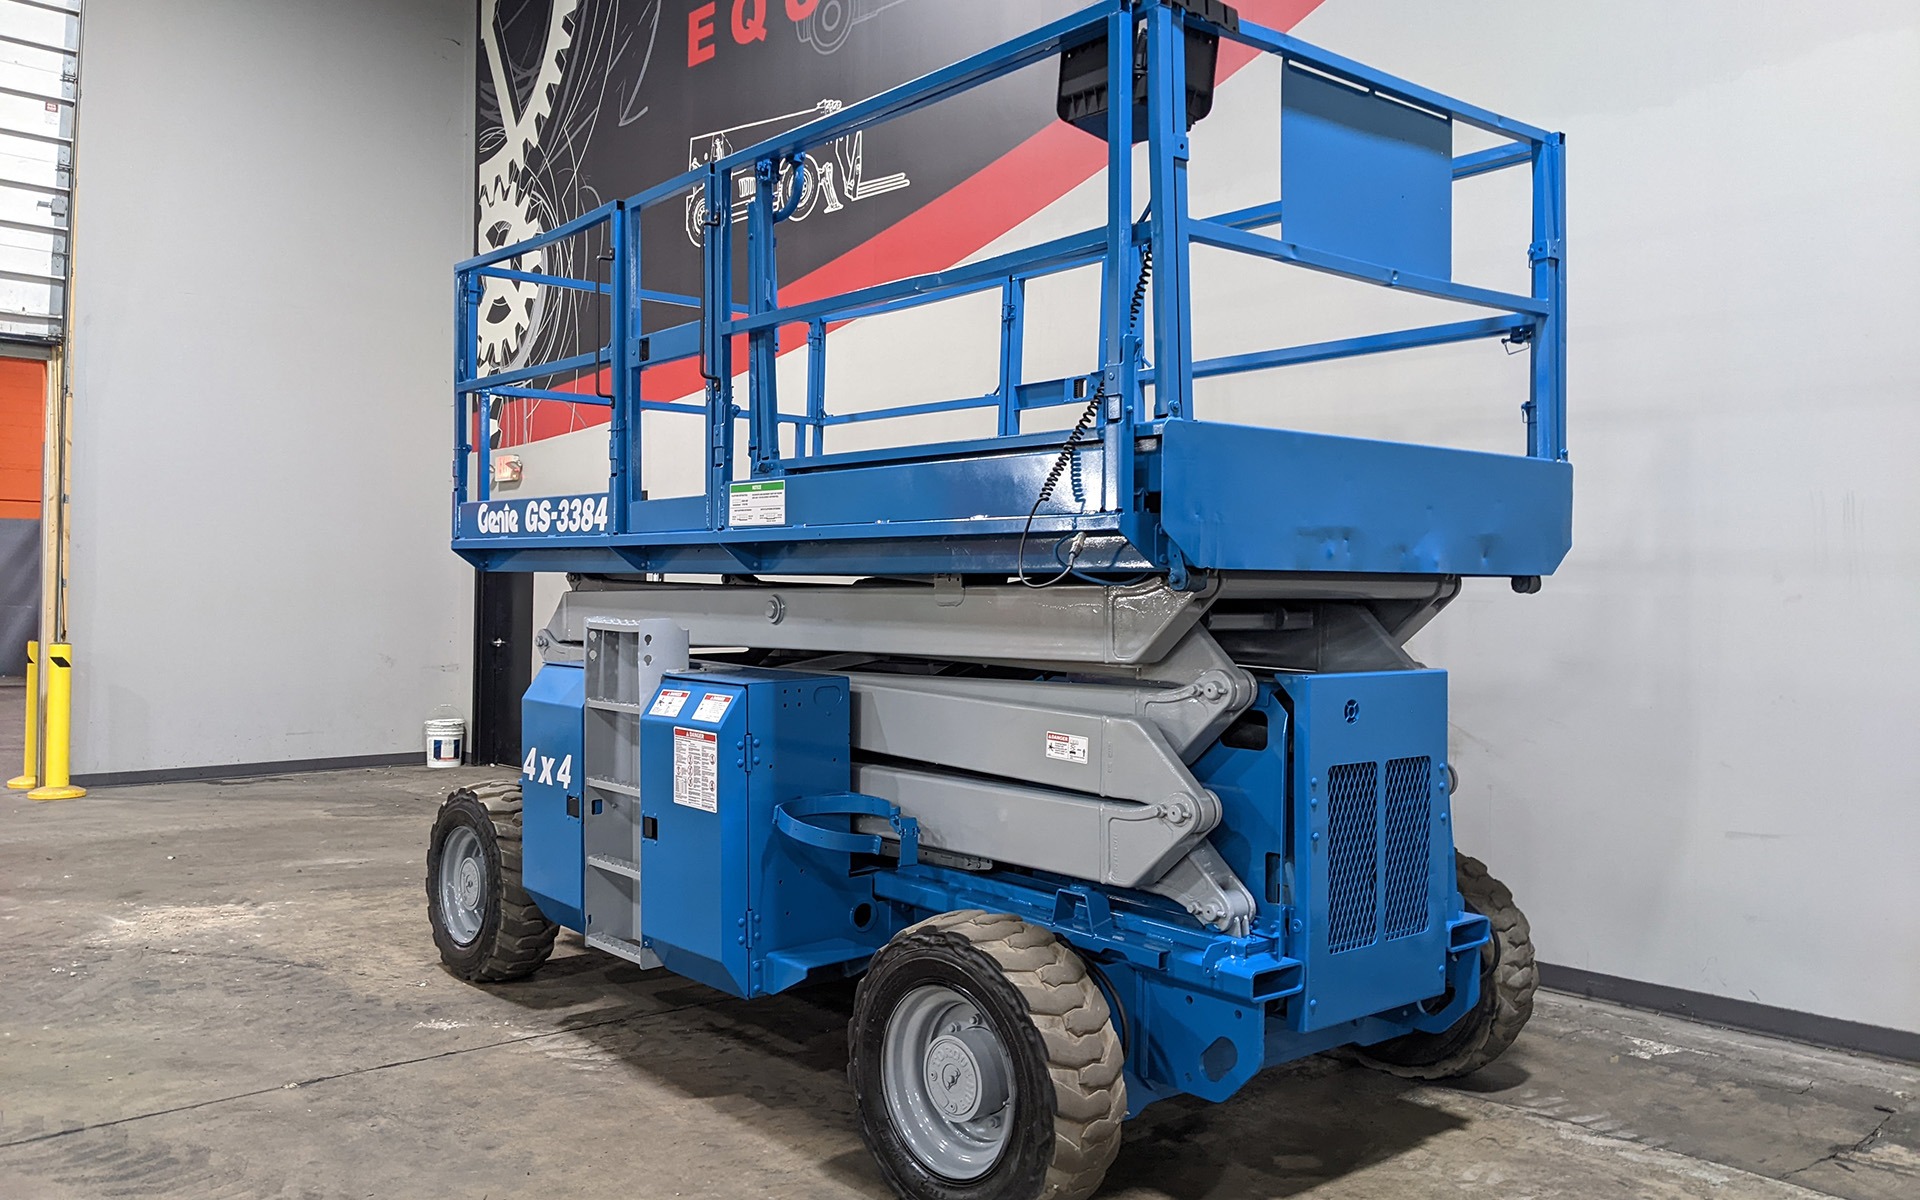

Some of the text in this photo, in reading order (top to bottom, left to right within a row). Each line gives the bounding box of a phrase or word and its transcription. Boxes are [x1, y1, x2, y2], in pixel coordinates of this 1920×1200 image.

[477, 496, 608, 534] Genie GS-3384
[689, 731, 705, 740] DANGER
[1050, 733, 1069, 742] DANGER
